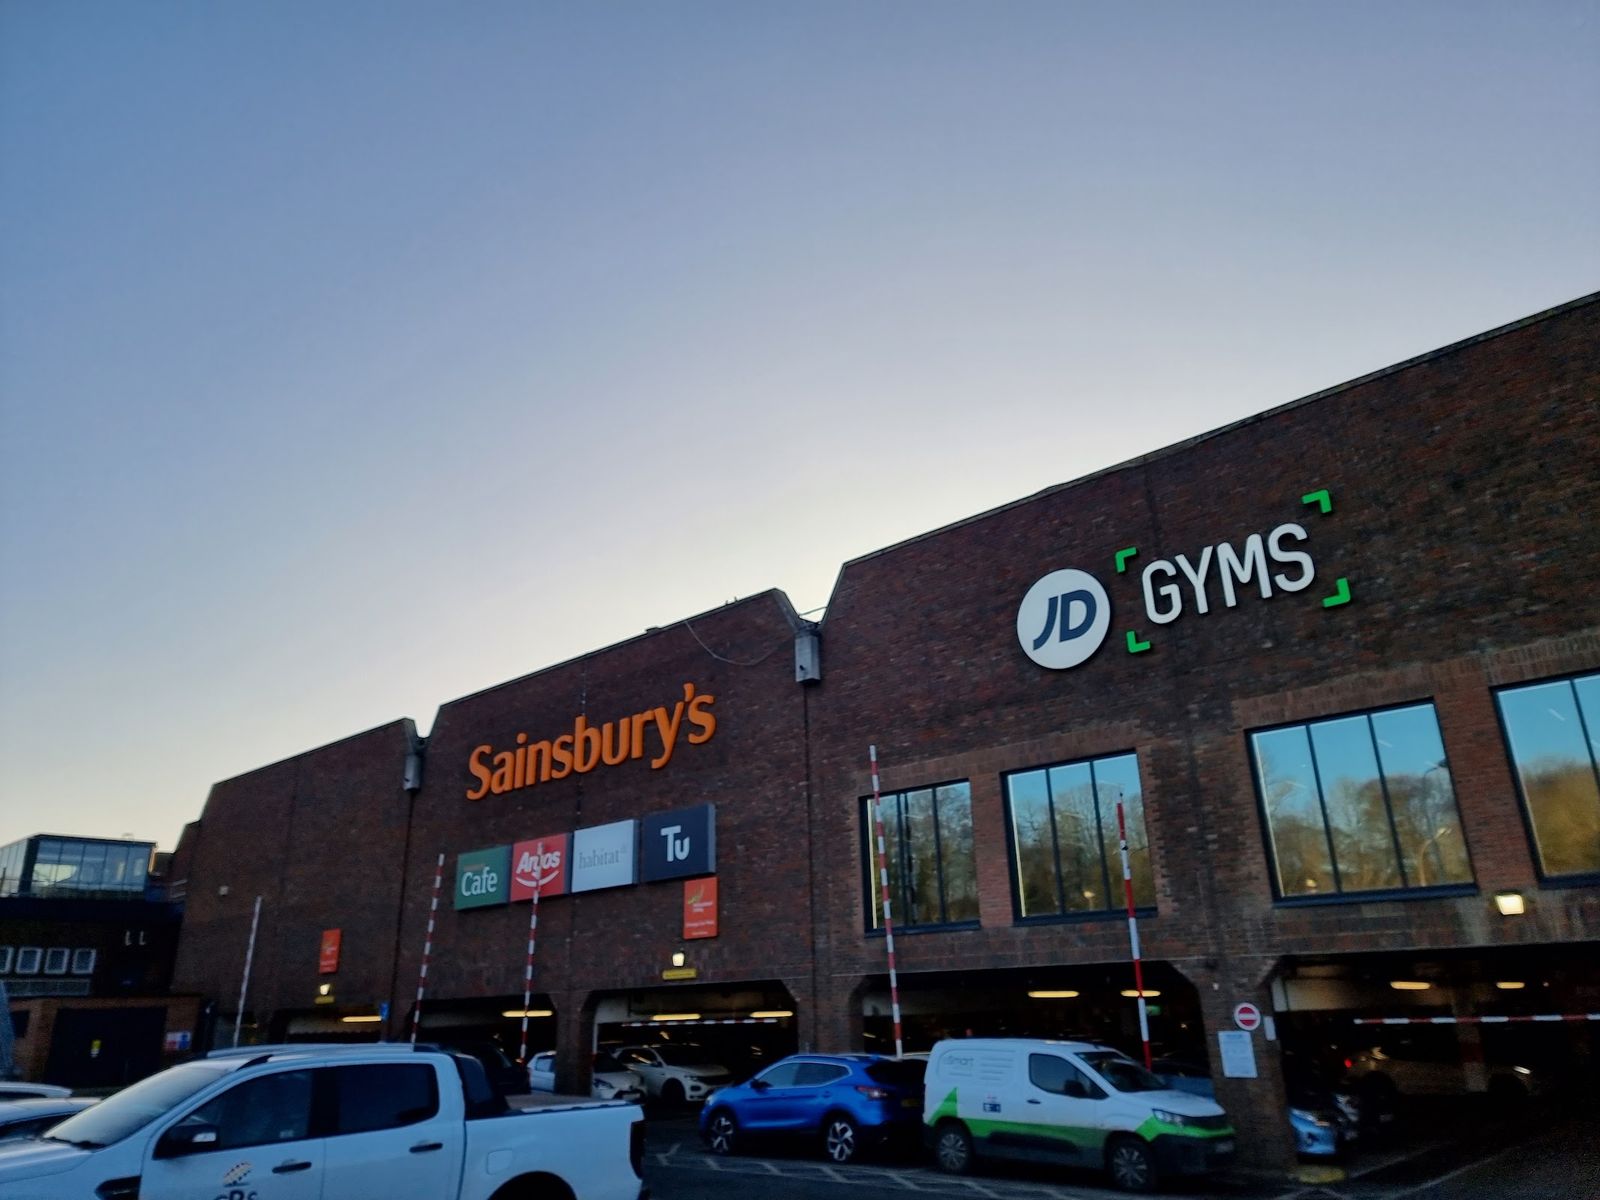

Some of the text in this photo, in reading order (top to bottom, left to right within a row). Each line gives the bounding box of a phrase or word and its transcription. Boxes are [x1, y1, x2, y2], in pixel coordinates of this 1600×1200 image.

[1032, 522, 1315, 651] JD GYMS
[465, 682, 717, 801] Sainsbury's
[461, 866, 498, 897] Cafe
[660, 824, 691, 862] Tu
